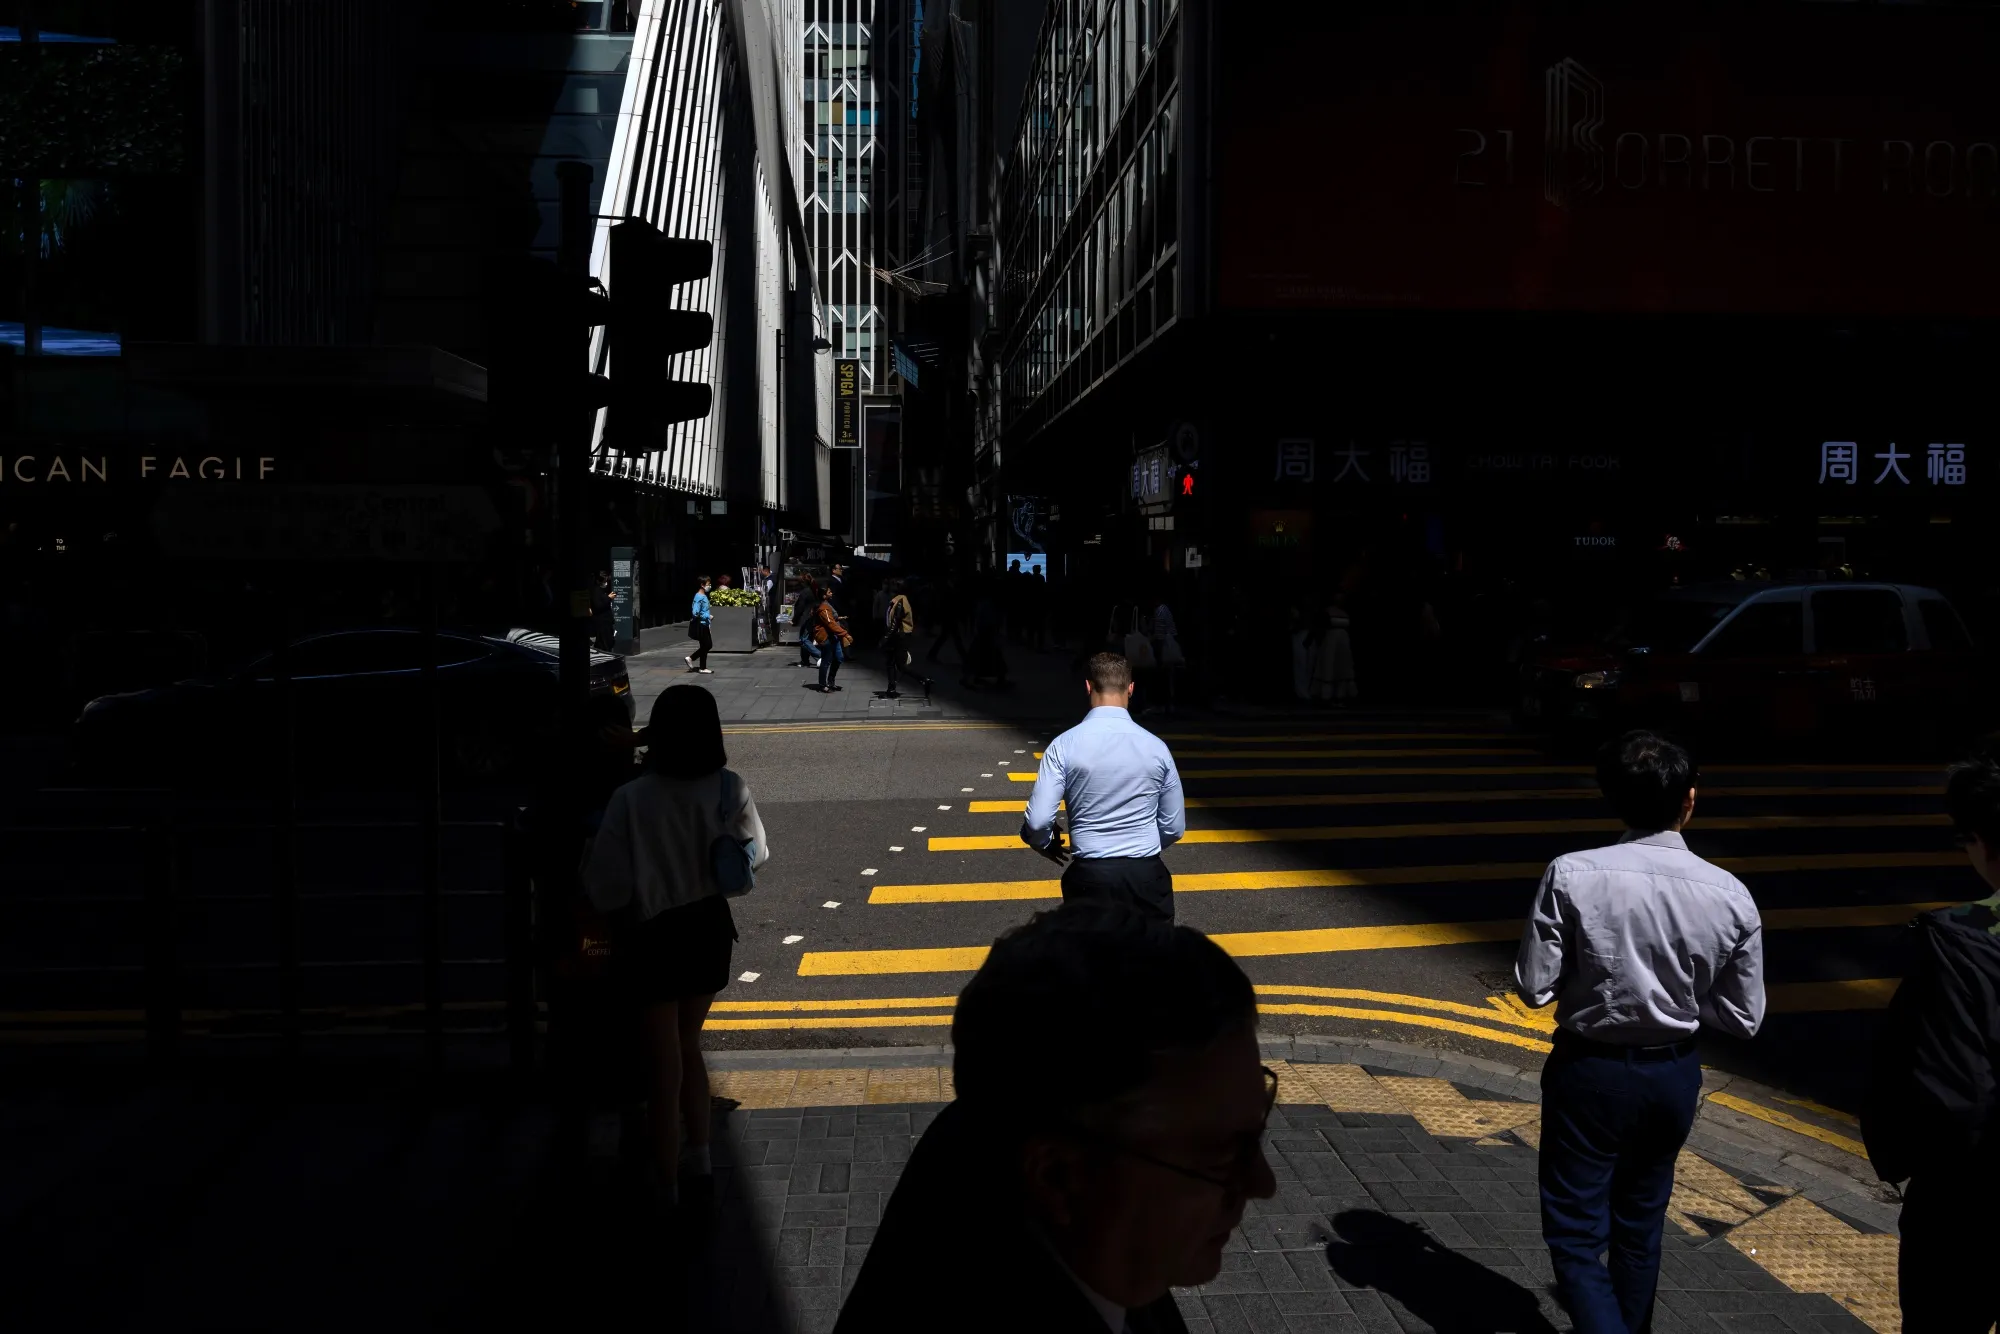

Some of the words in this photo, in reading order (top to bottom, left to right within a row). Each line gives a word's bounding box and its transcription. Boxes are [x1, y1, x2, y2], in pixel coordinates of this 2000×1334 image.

[1453, 127, 1514, 187] 21
[840, 363, 854, 396] SPIGA
[1132, 458, 1161, 499] 周大福
[1273, 437, 1431, 484] 周大福
[1568, 454, 1622, 470] FOOK
[1818, 440, 1967, 486] 周大福
[1574, 536, 1616, 546] TUDOR
[1850, 689, 1877, 702] TAXI
